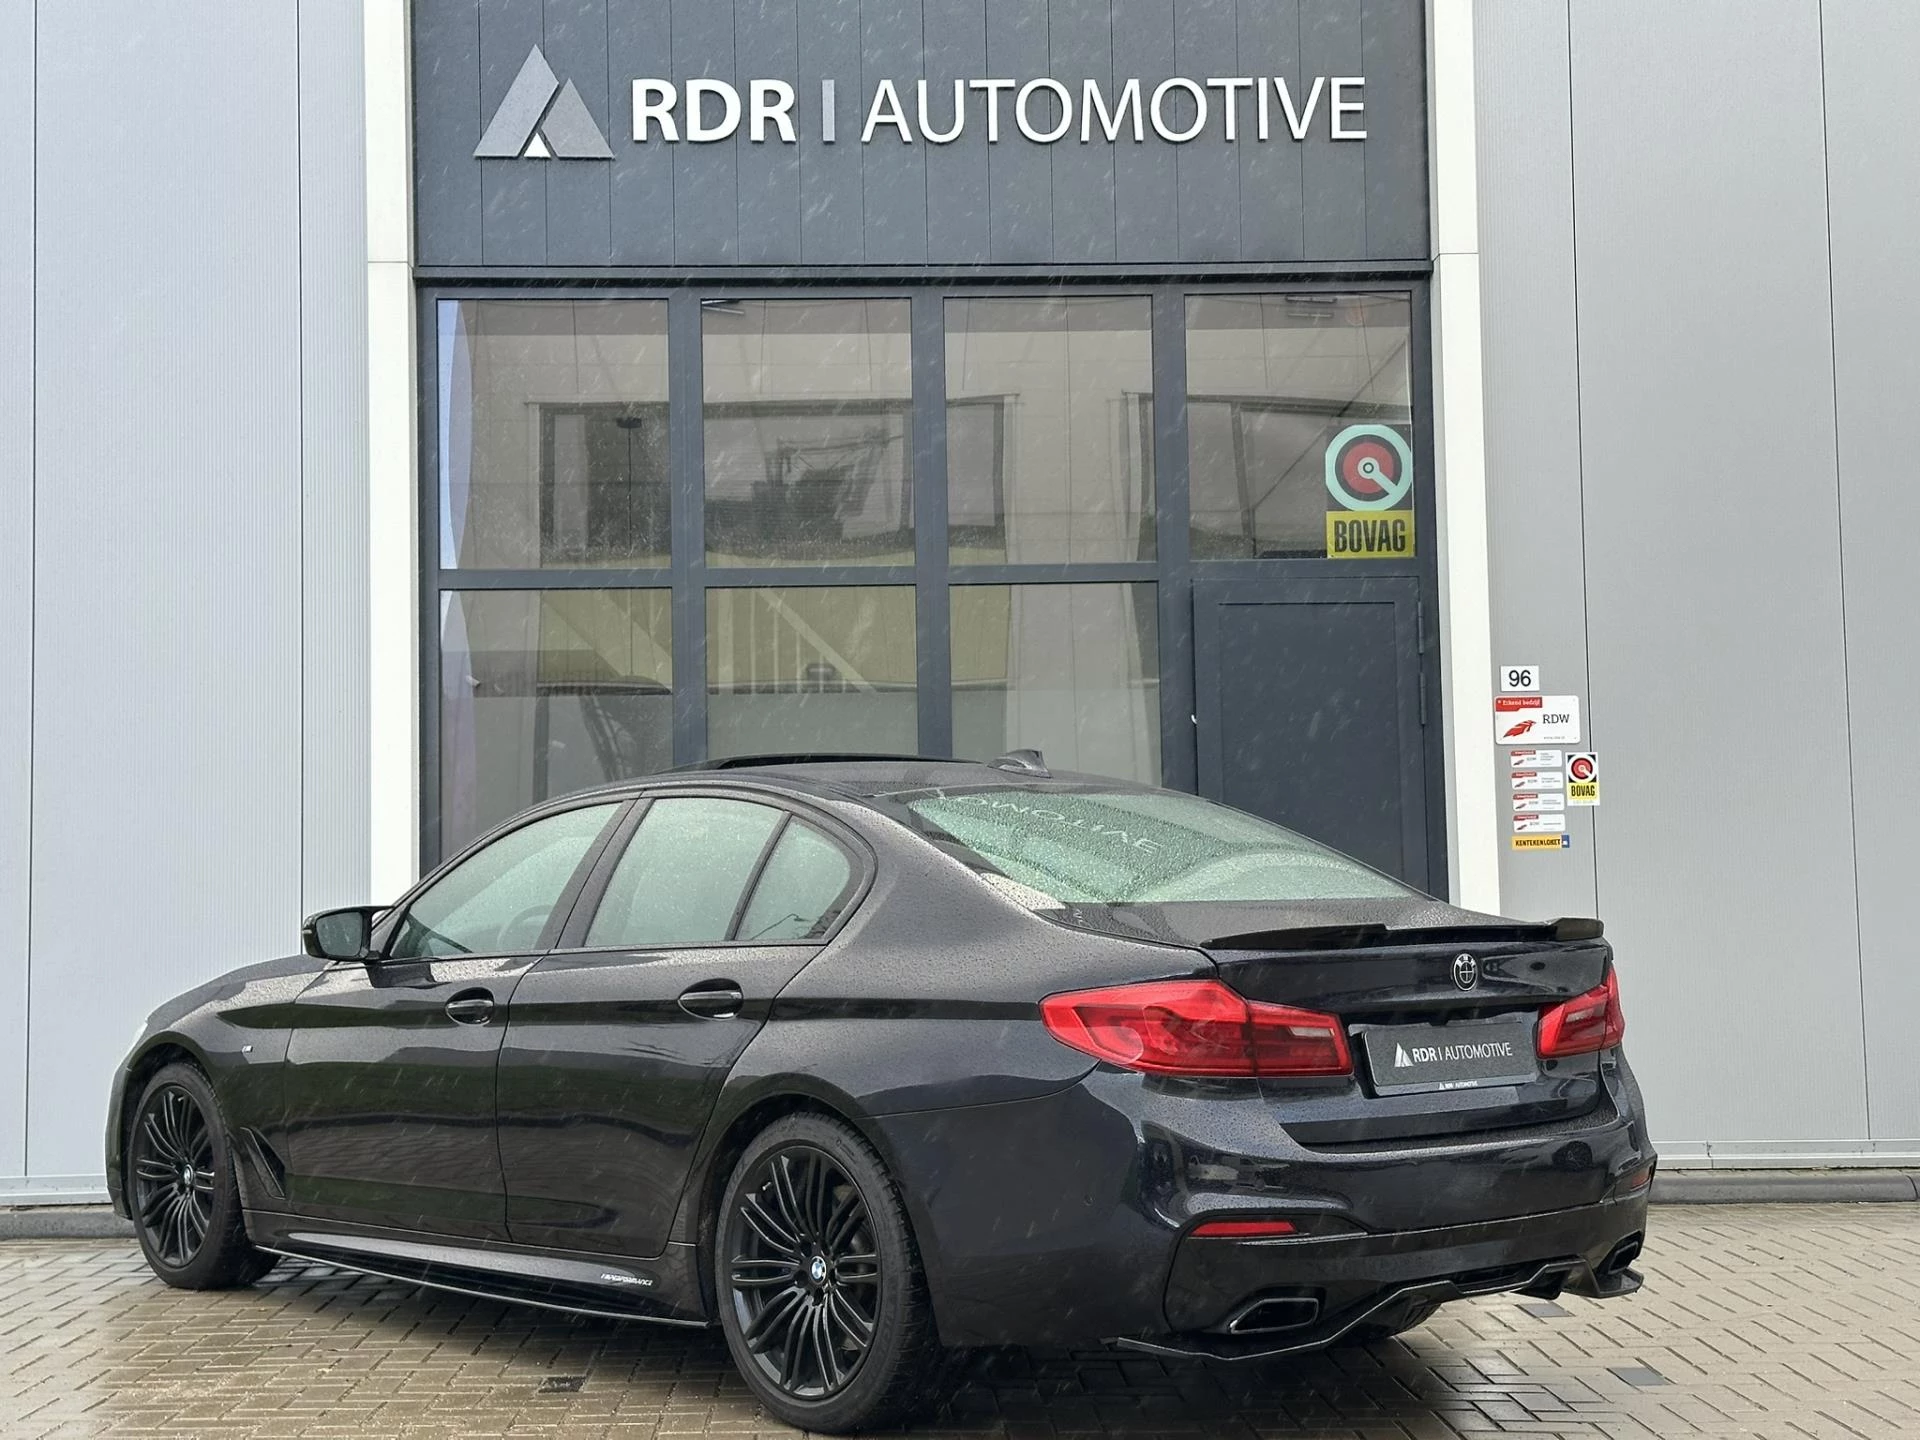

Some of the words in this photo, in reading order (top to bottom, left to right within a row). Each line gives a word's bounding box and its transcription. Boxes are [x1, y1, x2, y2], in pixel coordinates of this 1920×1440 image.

[631, 78, 797, 143] RDR
[861, 75, 1368, 144] AUTOMOTIVE
[1333, 519, 1406, 553] BOVAG
[1508, 669, 1532, 687] 96
[1542, 713, 1570, 724] RDW
[1571, 785, 1596, 797] BOVAG
[1412, 1046, 1438, 1063] RDR
[1445, 1042, 1513, 1061] AUTOMOTIVE
